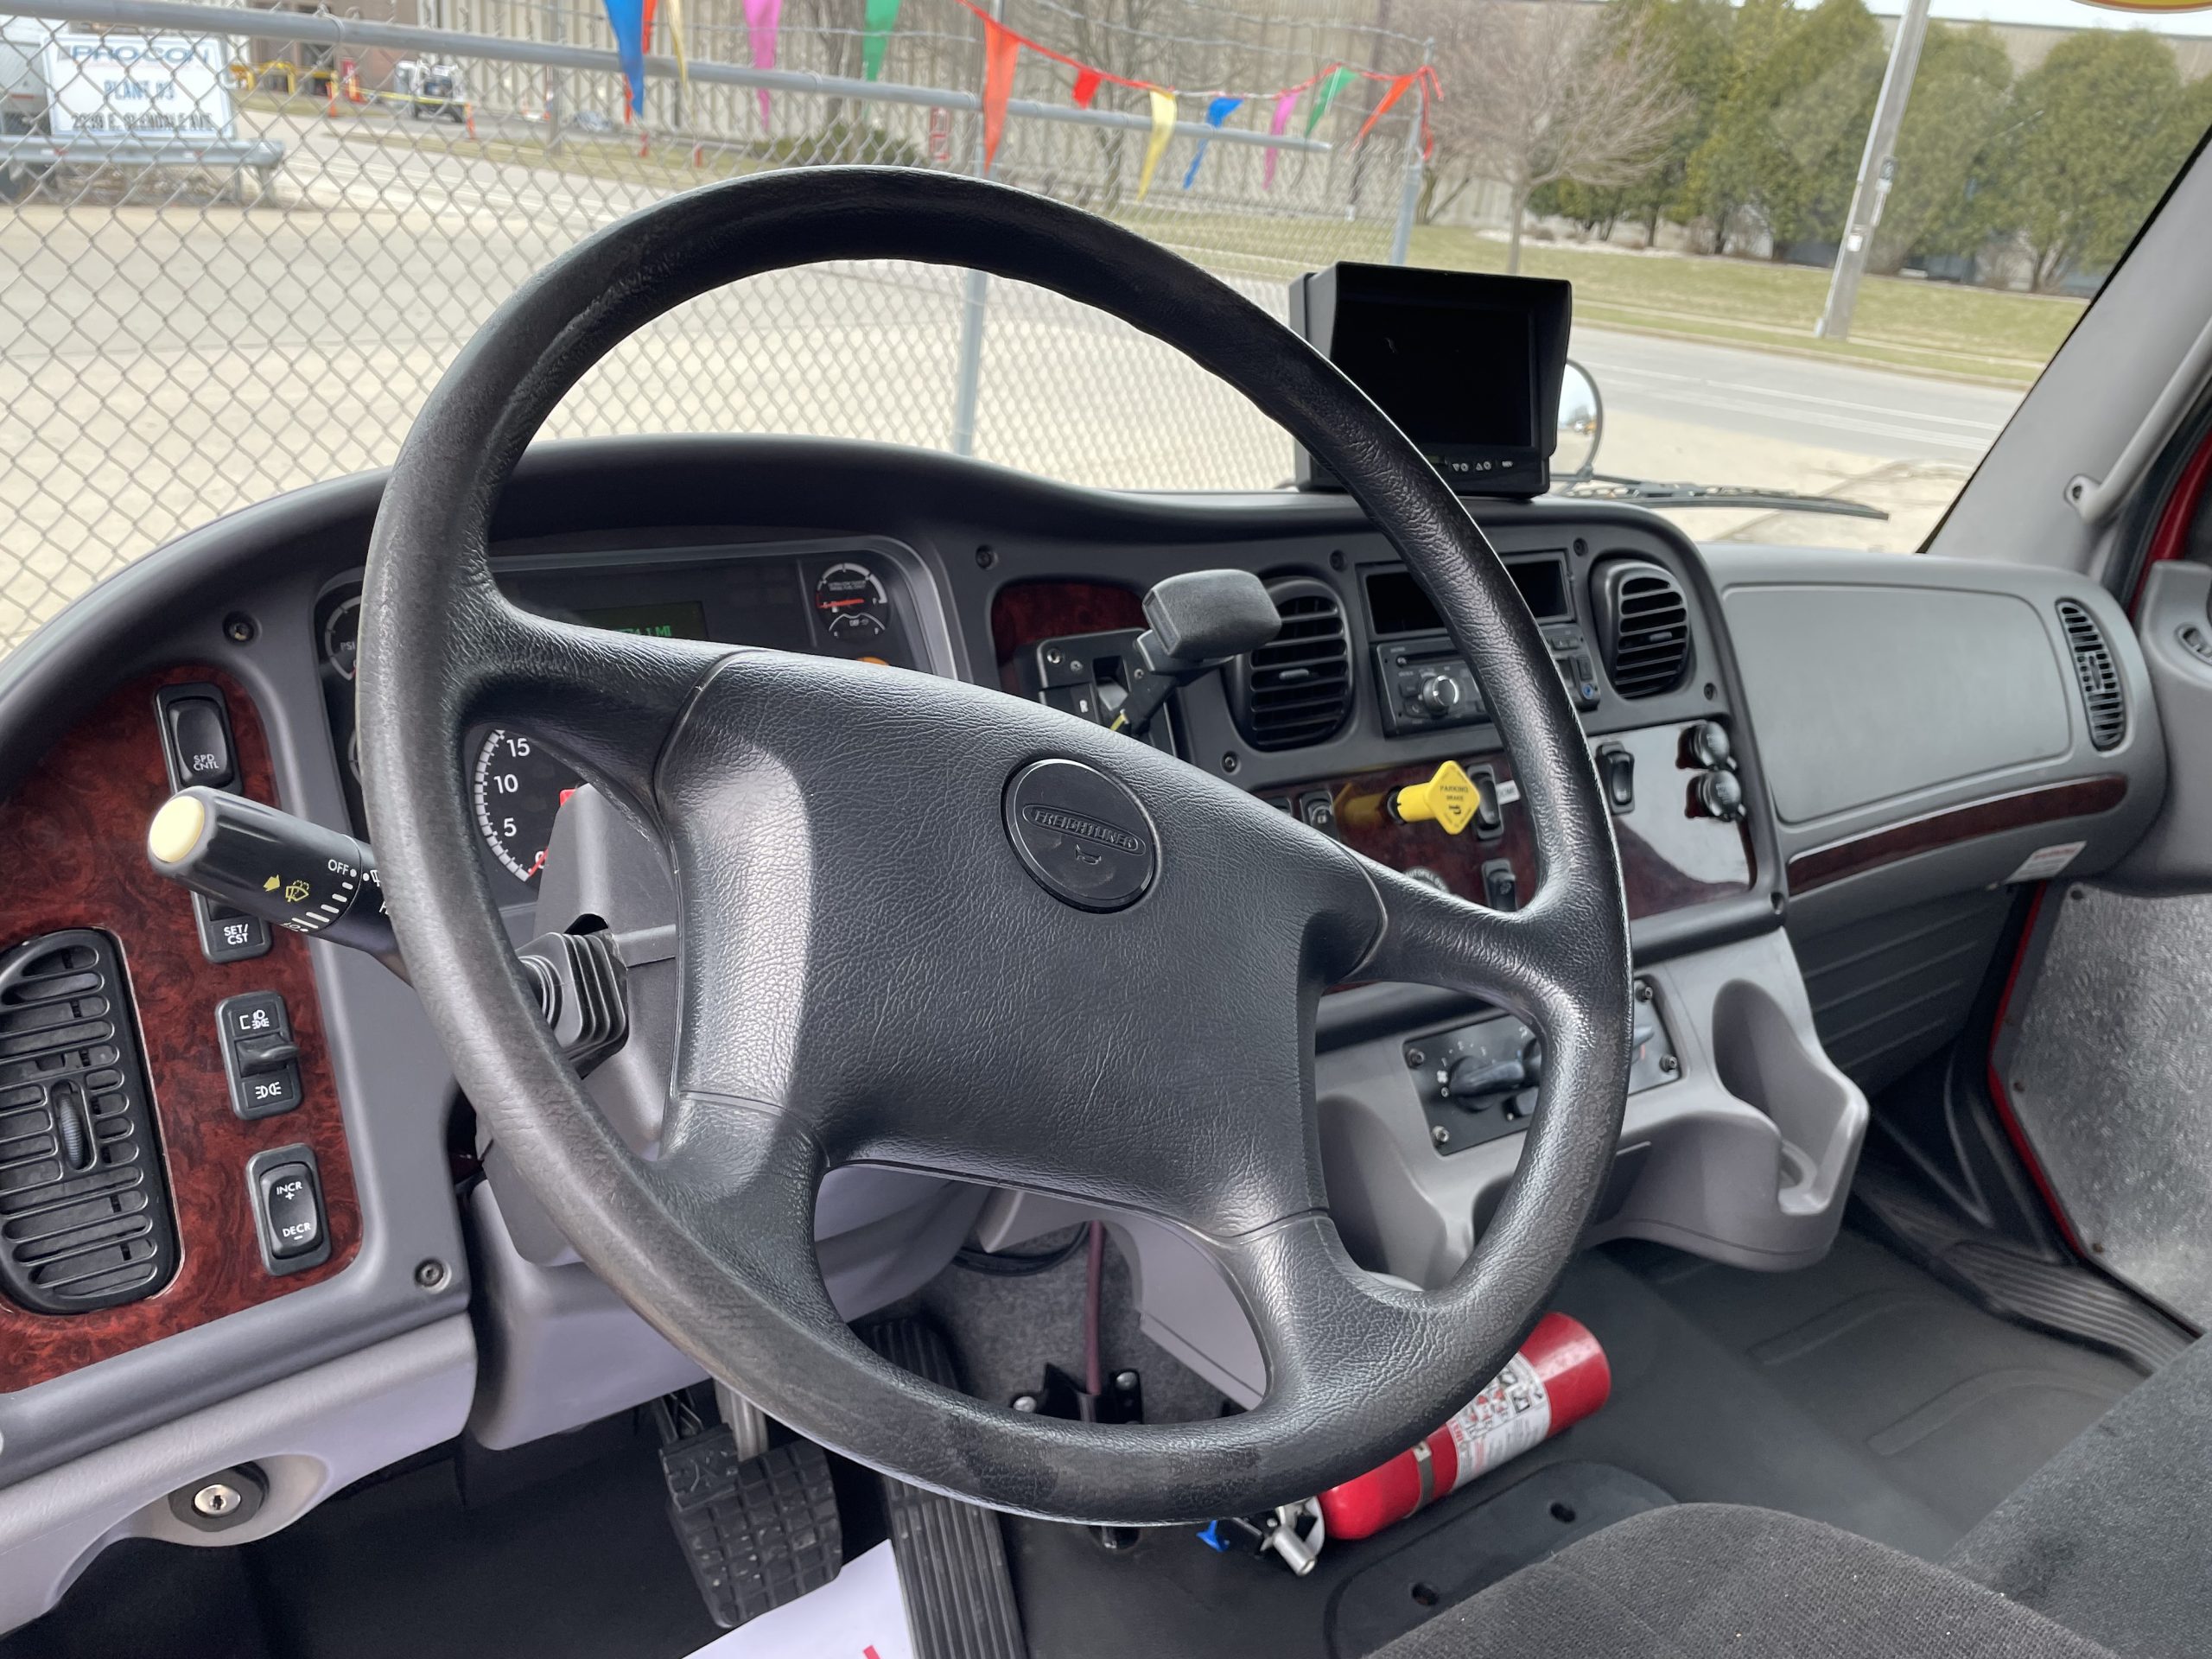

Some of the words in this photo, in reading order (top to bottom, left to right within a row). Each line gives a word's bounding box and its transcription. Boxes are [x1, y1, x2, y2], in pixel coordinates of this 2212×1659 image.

[1079, 699, 1089, 713] R
[506, 738, 531, 758] 15
[194, 753, 215, 763] SPD
[194, 761, 219, 771] CNTL
[493, 773, 518, 794] 10
[1440, 785, 1469, 793] PARKING
[504, 817, 517, 837] 5
[1034, 810, 1133, 849] FREIGHTLINER
[328, 859, 350, 875] OFF
[224, 924, 249, 936] SET/
[227, 933, 248, 944] CST
[276, 1181, 303, 1195] INCR
[283, 1222, 312, 1237] DECR
